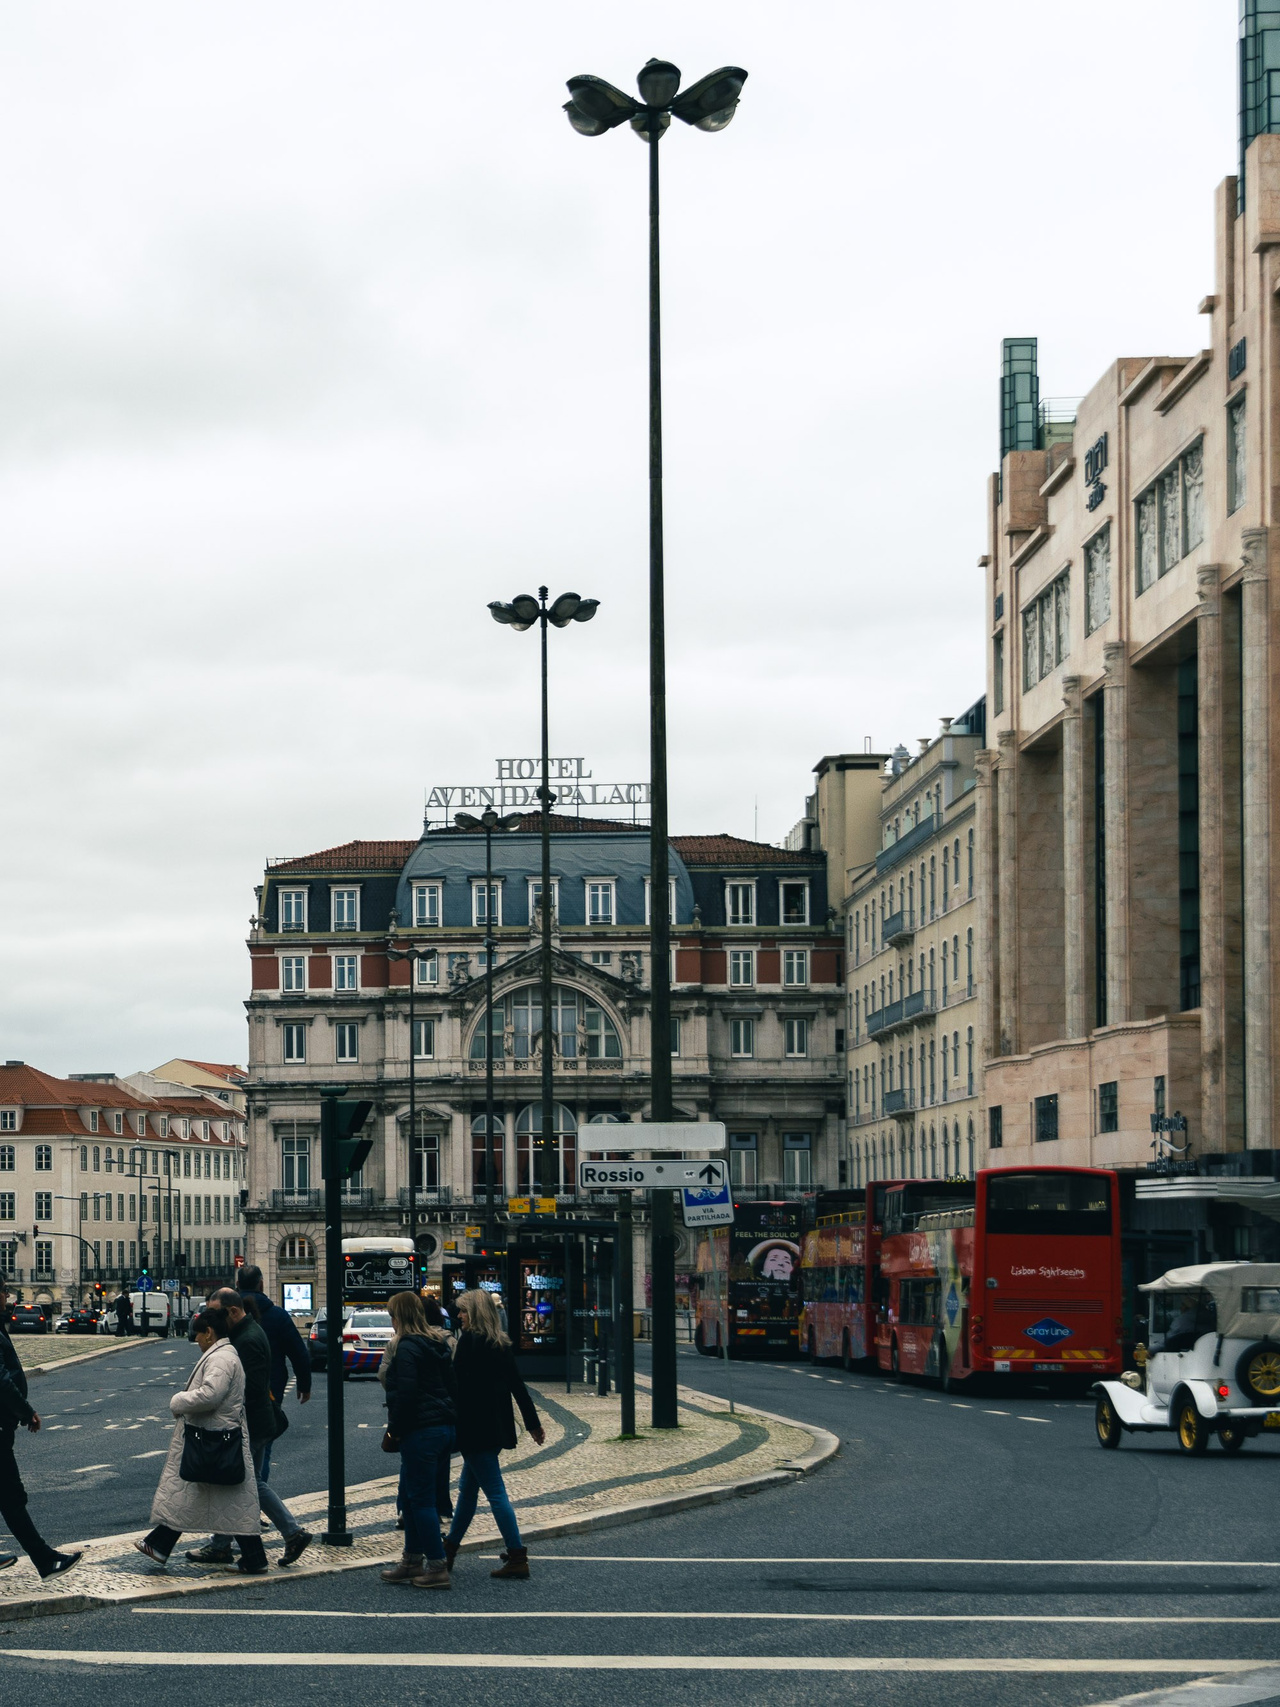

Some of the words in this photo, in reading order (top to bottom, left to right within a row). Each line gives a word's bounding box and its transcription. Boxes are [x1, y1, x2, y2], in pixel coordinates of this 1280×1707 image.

[495, 757, 592, 779] HOTEL
[584, 1167, 645, 1183] Rossio
[687, 1213, 730, 1222] PARTILHADA
[1010, 1265, 1036, 1276] Lisbon
[1038, 1265, 1086, 1279] Sightseeing
